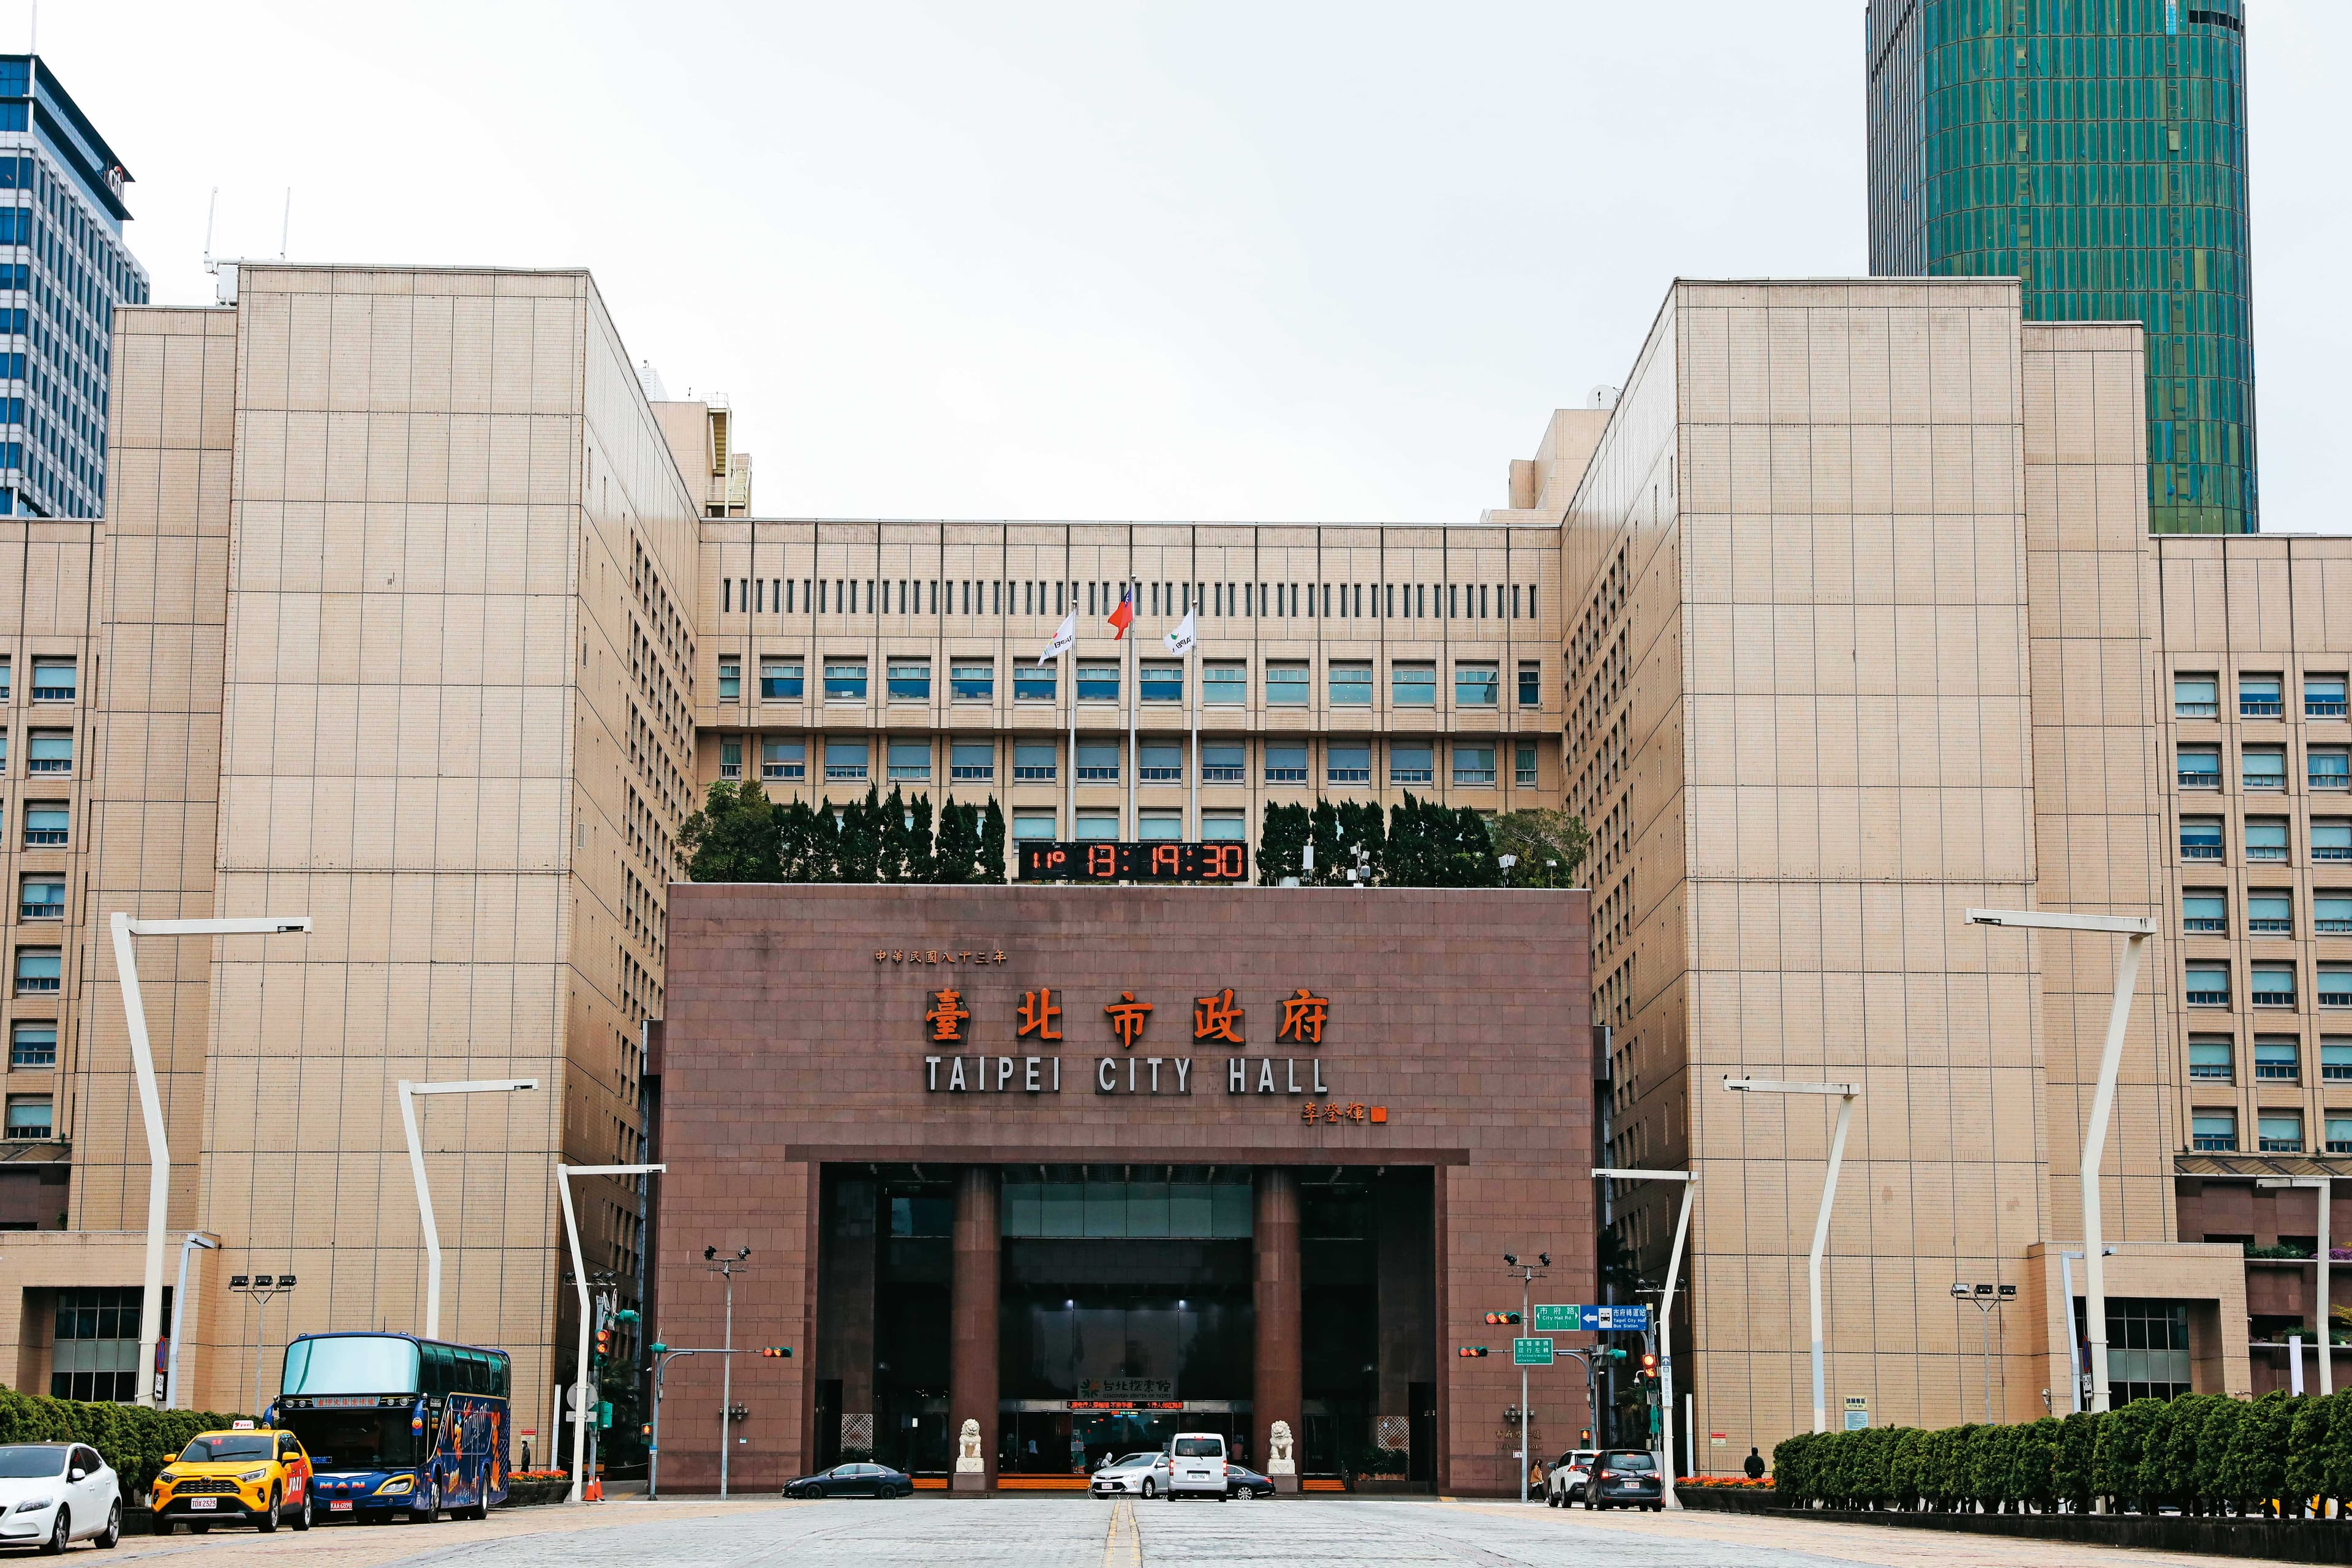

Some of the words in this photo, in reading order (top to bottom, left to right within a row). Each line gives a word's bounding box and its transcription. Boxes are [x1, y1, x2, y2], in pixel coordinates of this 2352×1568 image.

[1088, 845, 1243, 878] 13:19:30
[875, 949, 1008, 966] 中華民國八十三年
[925, 988, 1329, 1048] 臺北市政府
[925, 1056, 1060, 1091] TAIPEI
[1099, 1057, 1191, 1092] CITY
[1229, 1058, 1328, 1093] HALL
[1302, 1101, 1365, 1126] 李登輝
[1499, 1314, 1507, 1323] 46
[1613, 1308, 1646, 1317] 市府轉運站
[1645, 1368, 1654, 1377] 46
[288, 1469, 302, 1496] yoxi
